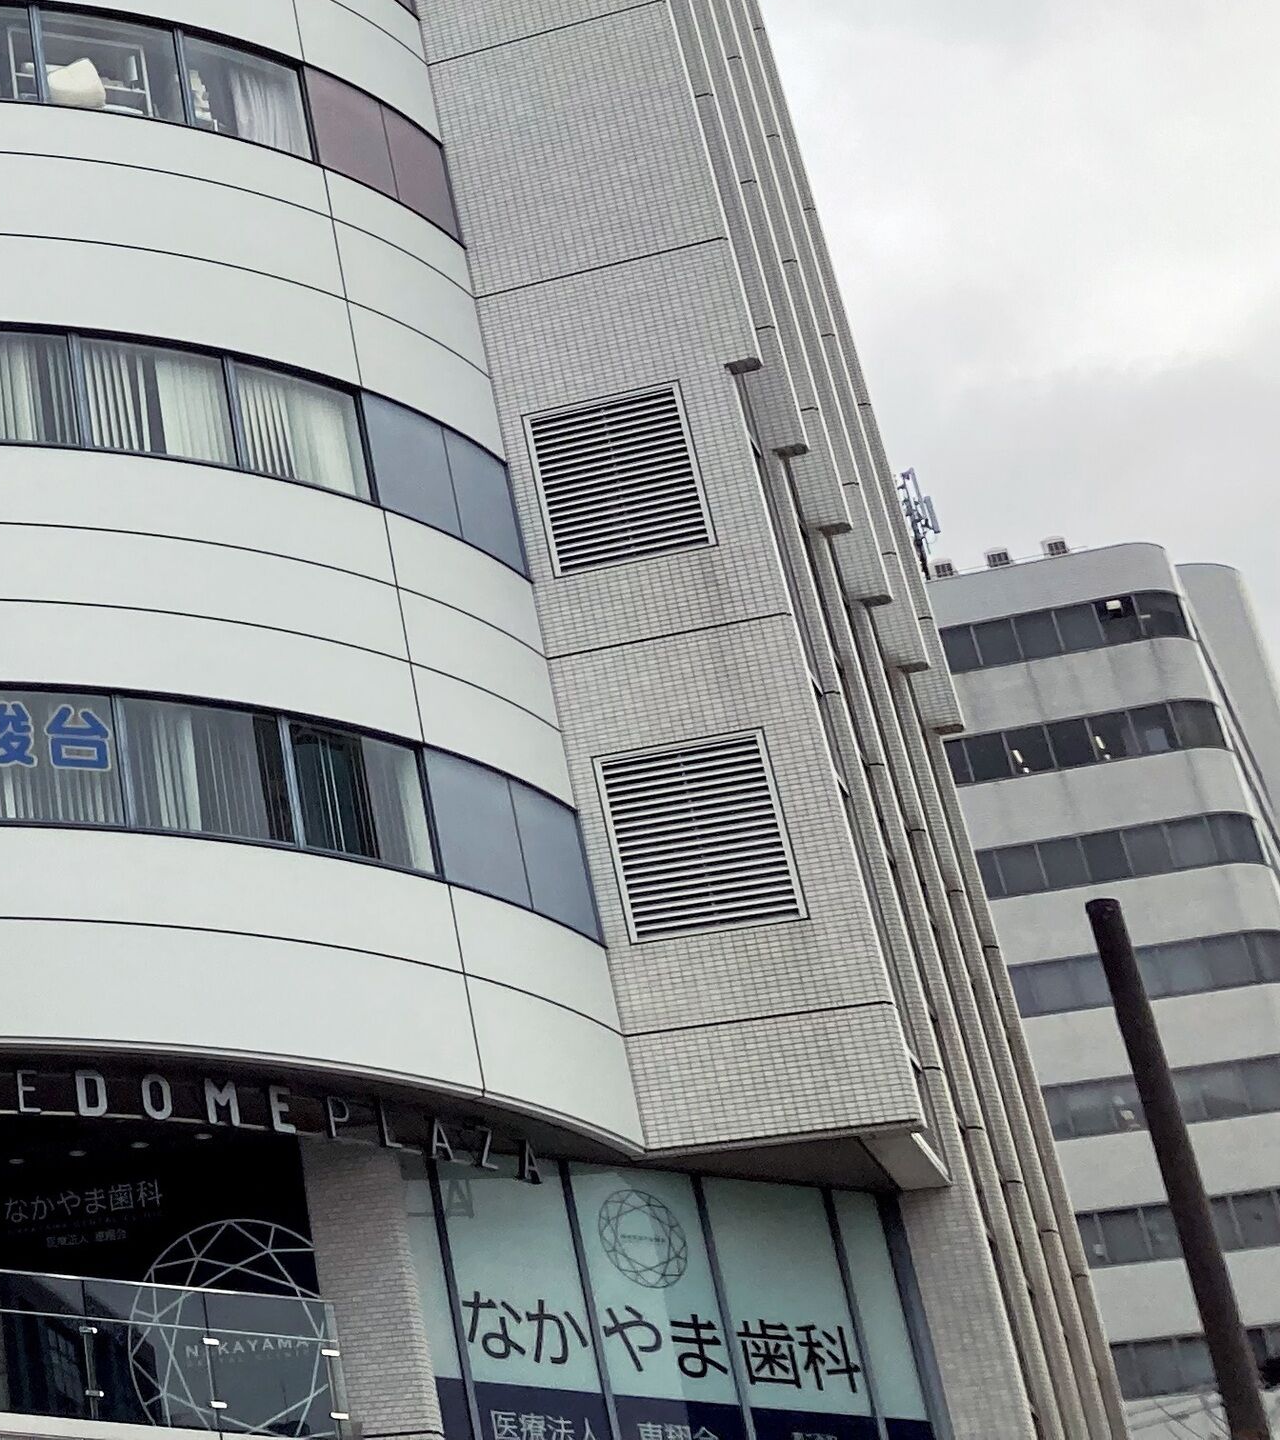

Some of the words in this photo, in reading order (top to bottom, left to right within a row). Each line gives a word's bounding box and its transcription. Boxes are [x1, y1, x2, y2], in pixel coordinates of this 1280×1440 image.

[76, 1073, 297, 1133] DOME
[4, 1178, 163, 1223] なかやま歯科
[185, 1337, 311, 1359] NKAYAMA
[461, 1290, 861, 1394] なかやま歯科
